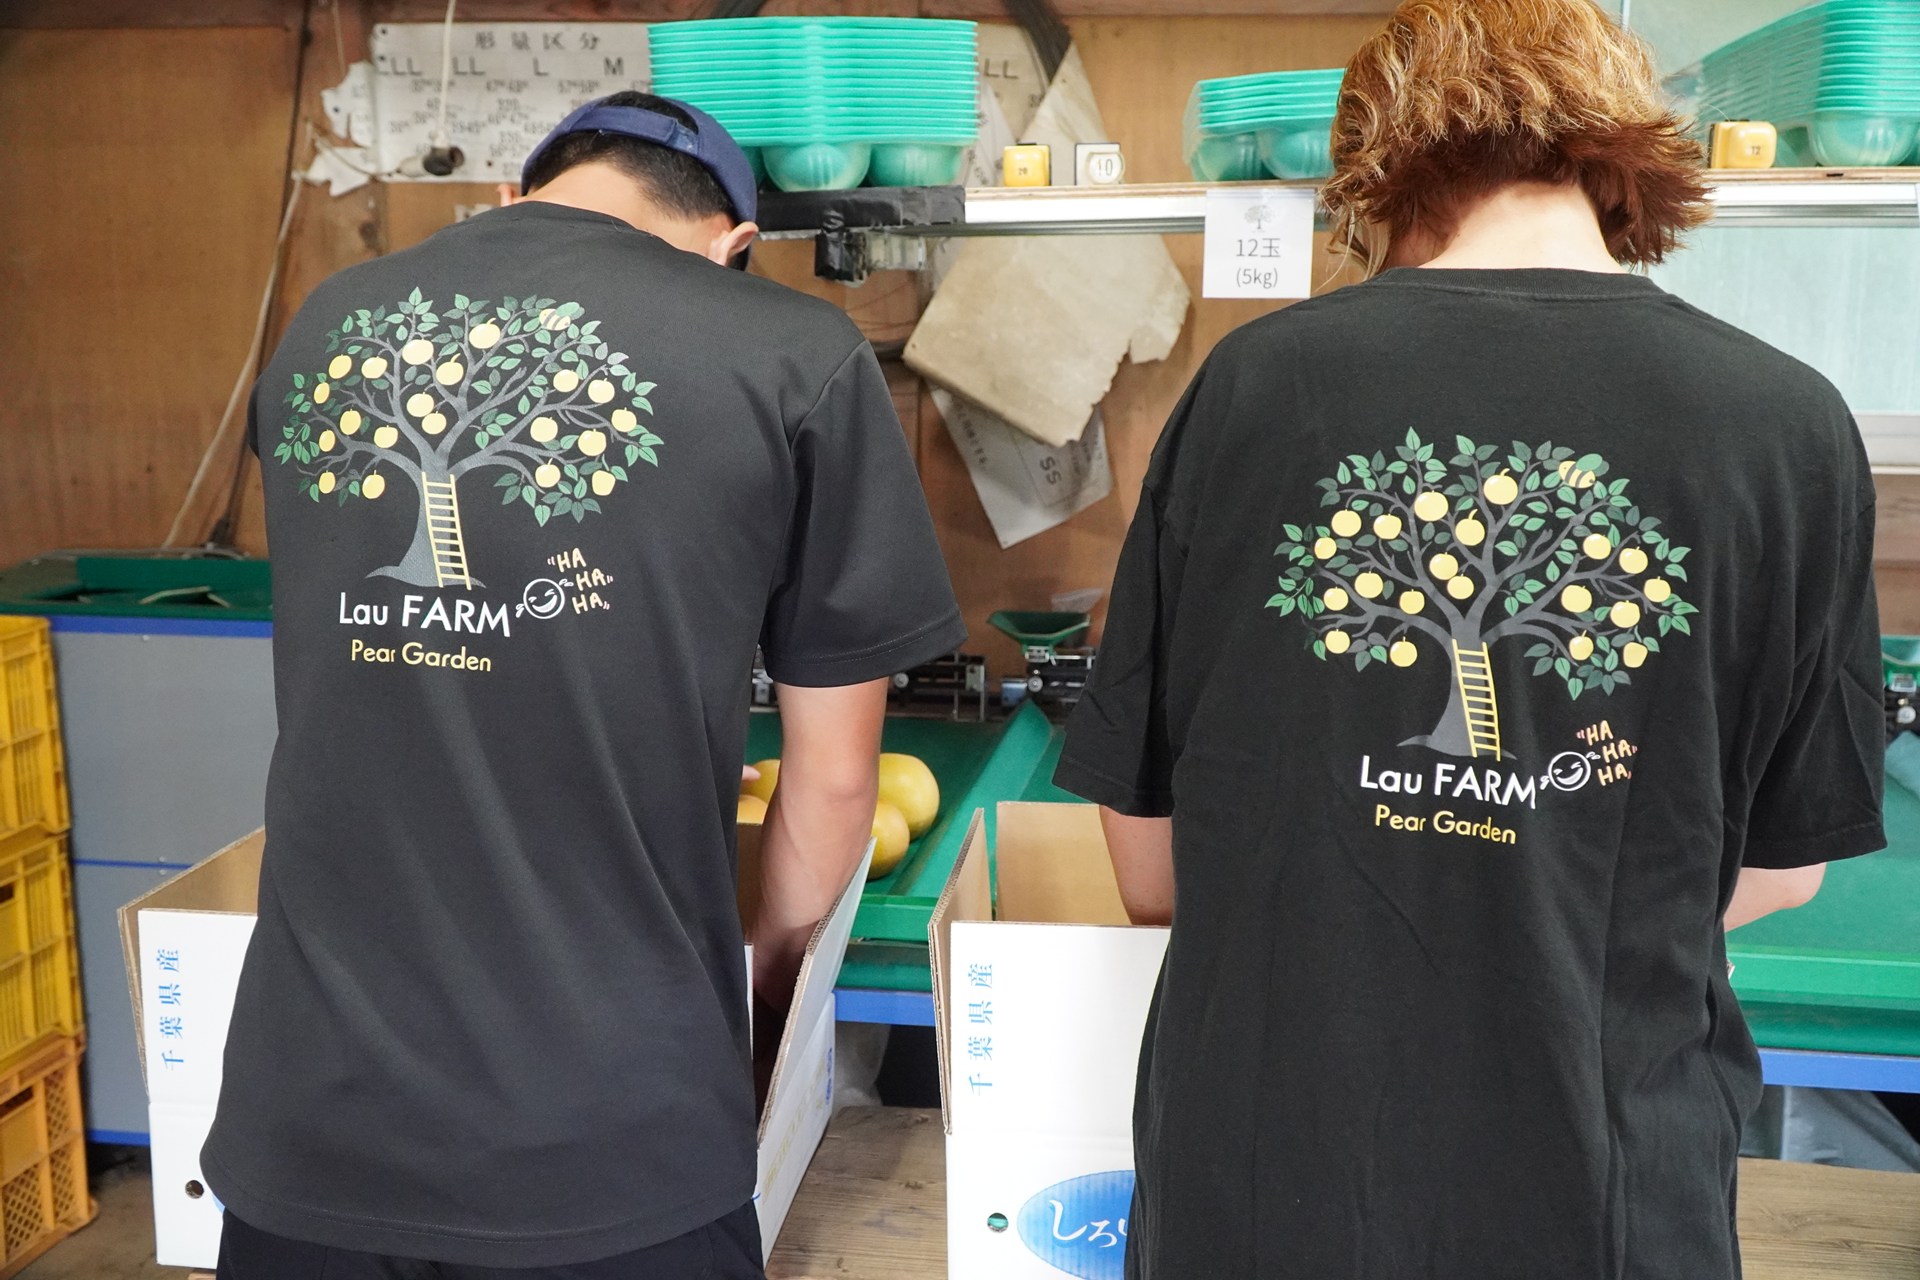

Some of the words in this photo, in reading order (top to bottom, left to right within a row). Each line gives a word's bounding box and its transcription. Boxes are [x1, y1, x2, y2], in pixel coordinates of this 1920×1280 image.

[452, 57, 485, 75] LL
[532, 57, 549, 76] L
[603, 57, 624, 75] M
[1236, 238, 1281, 258] 12玉
[1236, 267, 1278, 289] (5kg)
[339, 592, 388, 626] Lau
[402, 594, 510, 637] FARM
[351, 639, 395, 663] Pear
[402, 642, 491, 672] Garden
[1360, 755, 1422, 794] Lau
[1434, 763, 1536, 809] FARM
[1375, 804, 1426, 831] Pear
[1433, 810, 1516, 845] Garden
[156, 949, 184, 1071] 千葉県産
[968, 963, 993, 1096] 千葉県産
